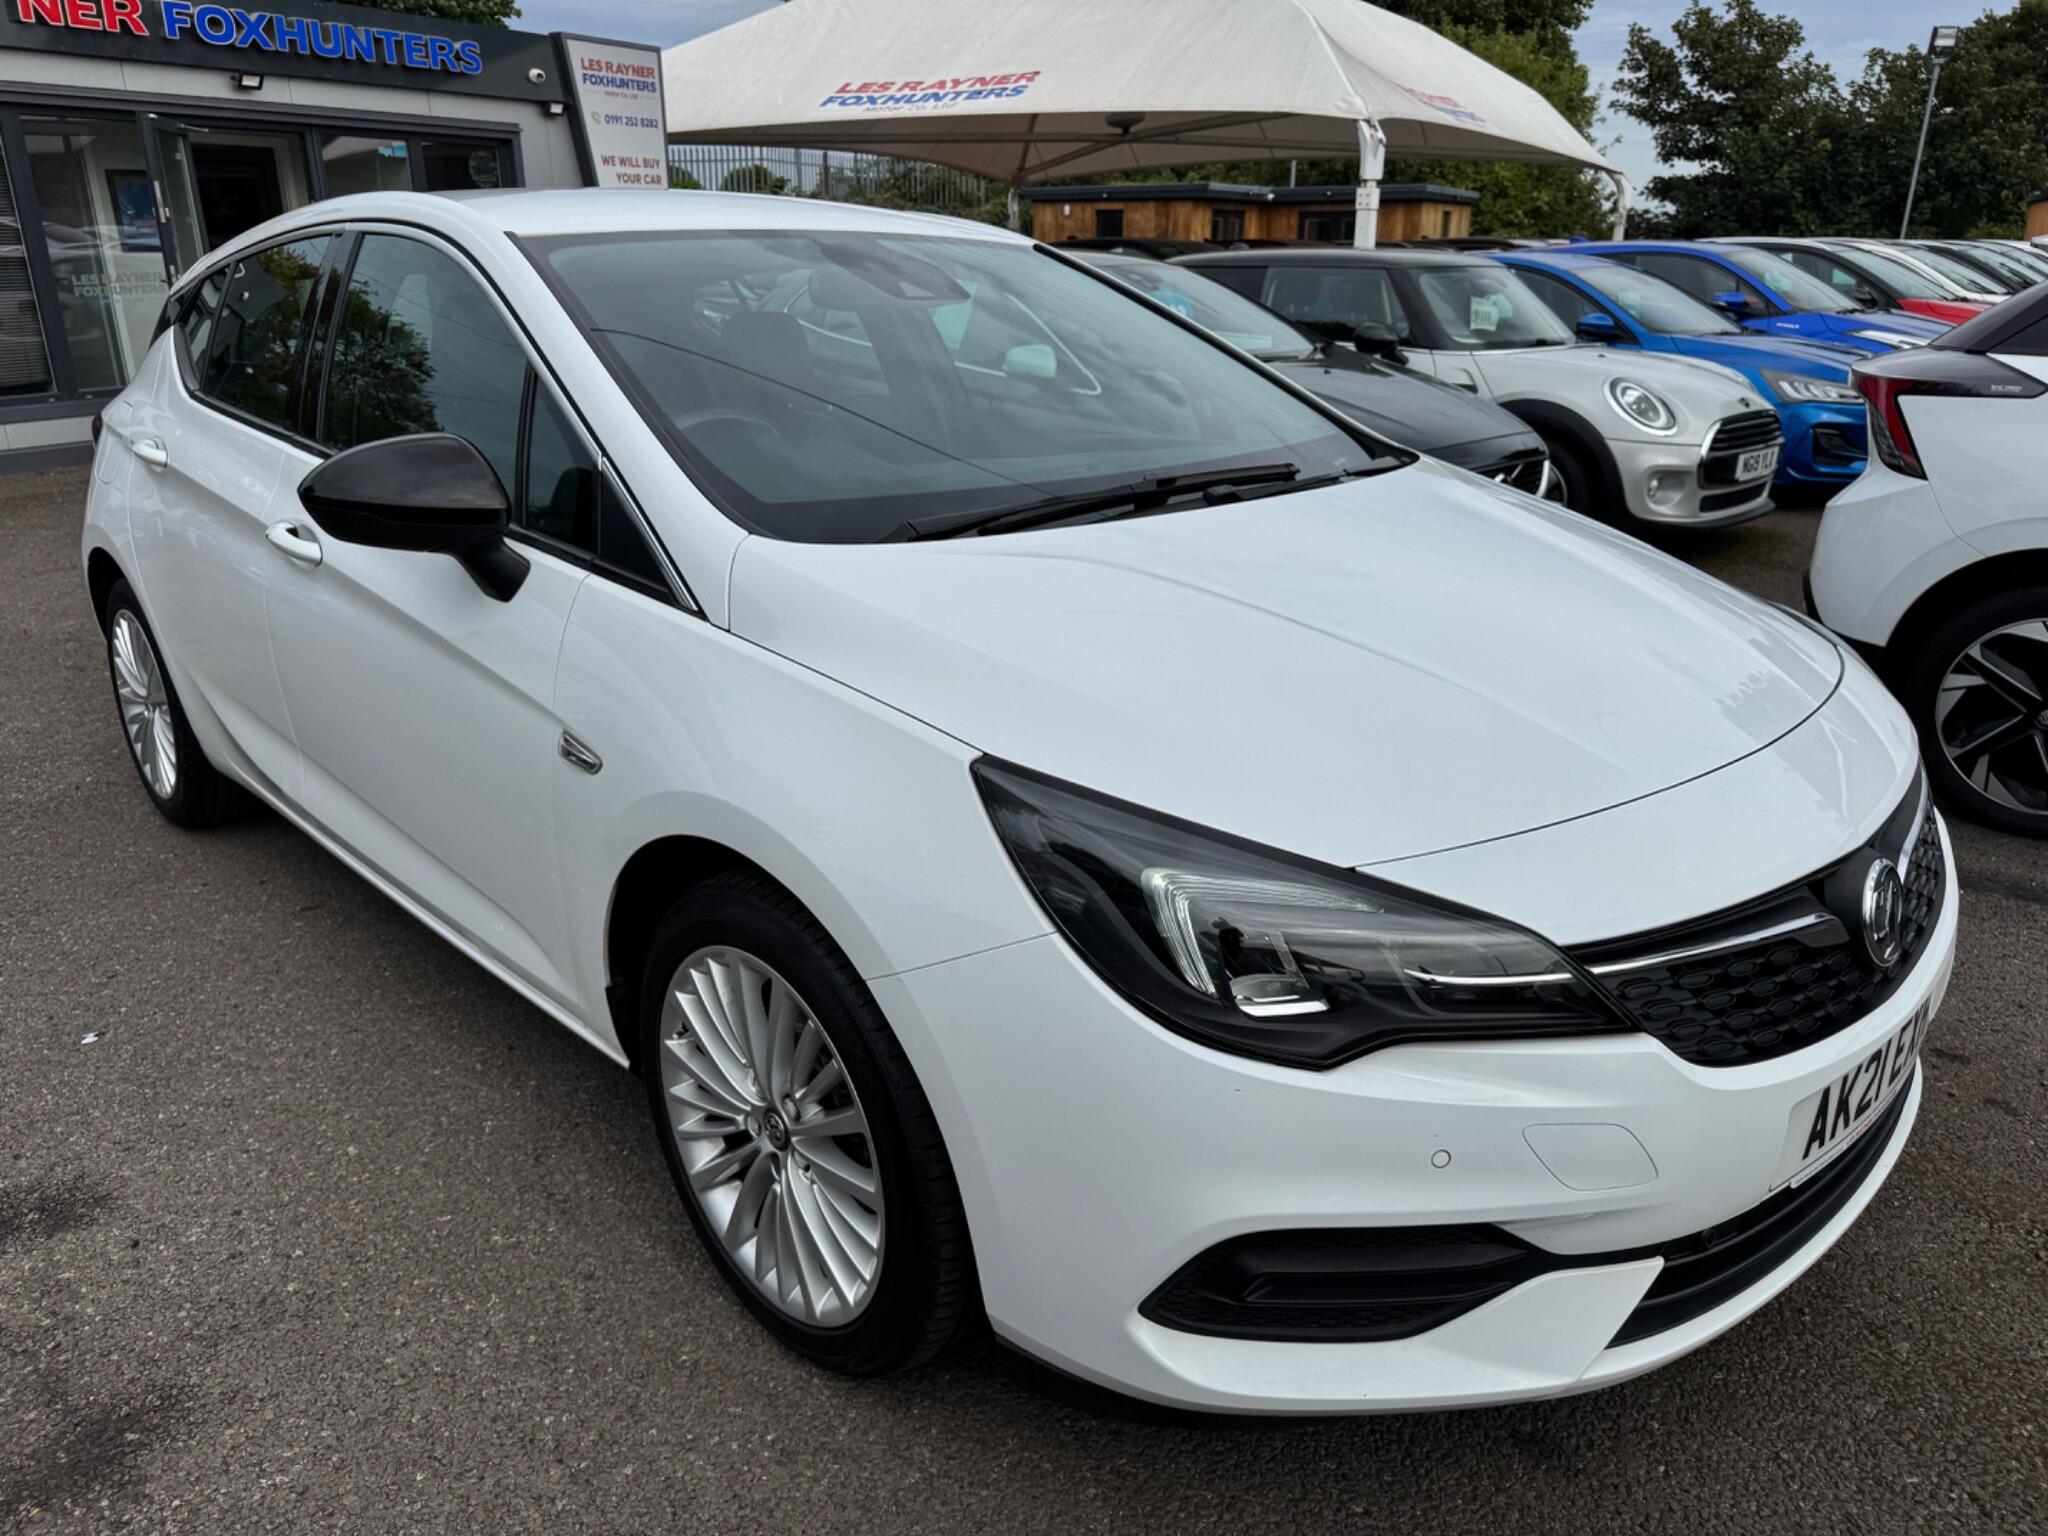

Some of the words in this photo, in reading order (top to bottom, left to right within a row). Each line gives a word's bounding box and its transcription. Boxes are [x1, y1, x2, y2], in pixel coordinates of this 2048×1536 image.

[161, 0, 483, 75] FOXHUNTERS
[580, 58, 602, 72] LES
[605, 62, 656, 79] RAYNER
[582, 73, 657, 93] FOXHUNTERS
[834, 82, 897, 95] LES
[895, 70, 1041, 93] RAYNER
[819, 84, 1029, 107] FOXHUNTERS
[604, 113, 623, 125] 0191
[624, 115, 638, 127] 252
[601, 154, 616, 167] WE
[618, 155, 641, 169] WILL
[643, 158, 661, 170] BUY
[616, 172, 641, 184] YOUR
[643, 174, 662, 186] CAR
[72, 273, 98, 285] LES
